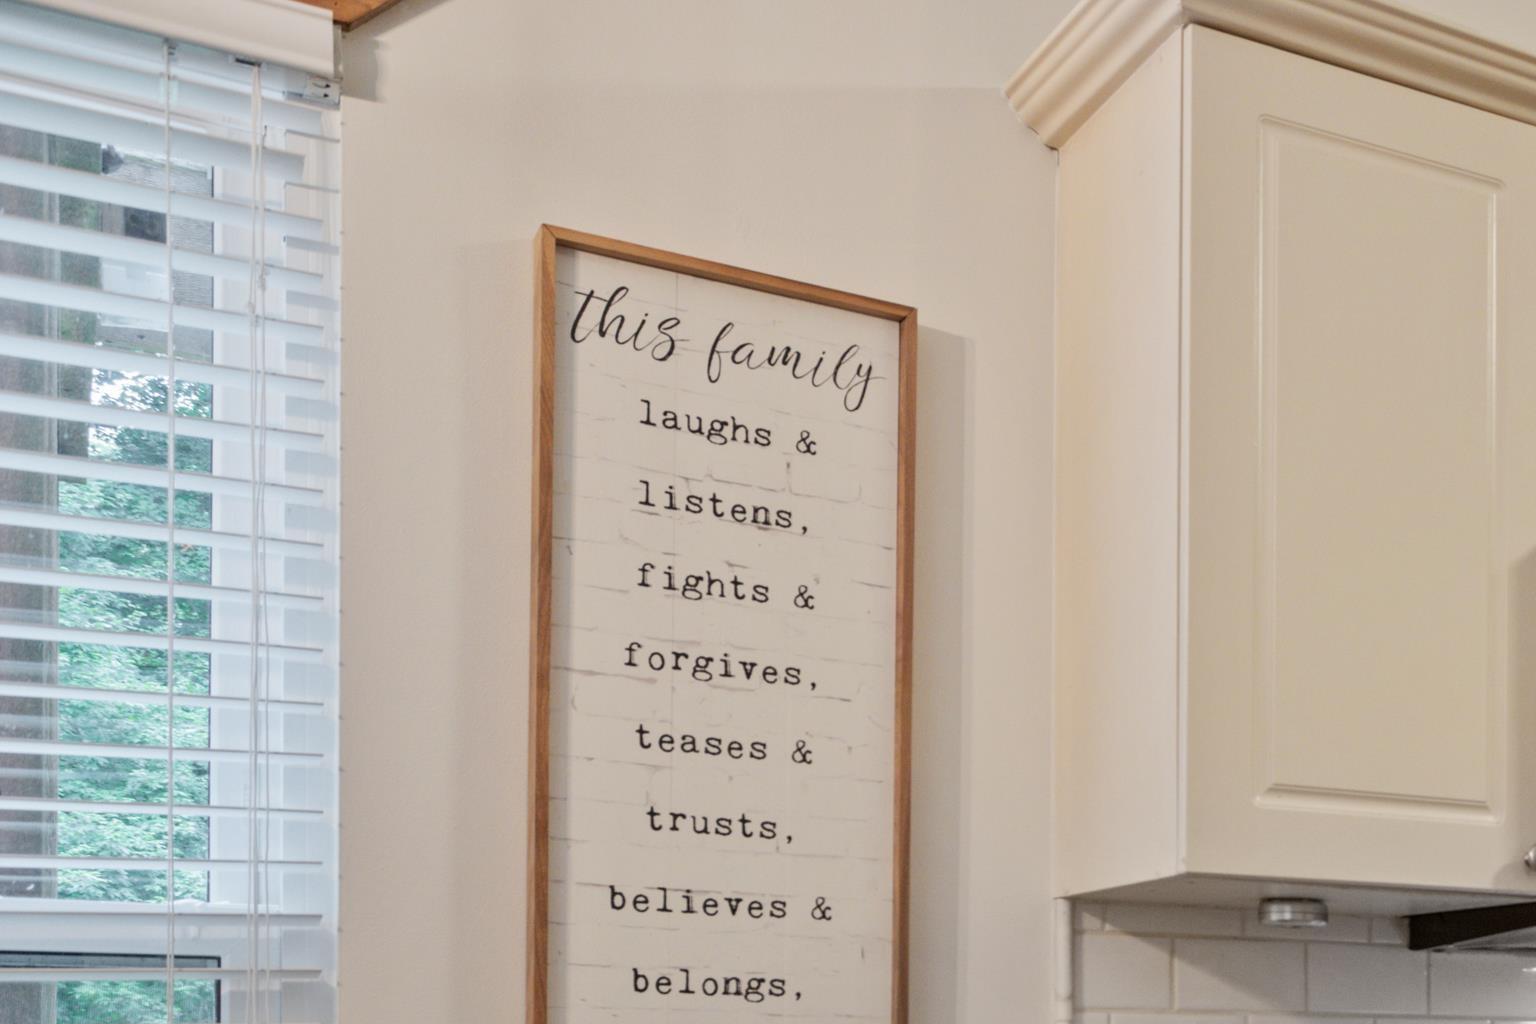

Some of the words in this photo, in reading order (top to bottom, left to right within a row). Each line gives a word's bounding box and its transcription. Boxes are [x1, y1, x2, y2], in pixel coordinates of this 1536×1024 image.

[570, 286, 690, 362] this
[706, 322, 887, 412] family
[639, 399, 772, 448] laughs
[795, 430, 817, 456] &
[638, 479, 808, 536] listens,
[637, 562, 770, 604] fights
[793, 584, 815, 611] &
[623, 641, 817, 691] forgives,
[634, 723, 767, 761] teases
[791, 739, 813, 765] &
[645, 805, 793, 845] trusts,
[609, 884, 787, 920] believes
[810, 896, 833, 922] &
[631, 967, 802, 1004] belongs,
